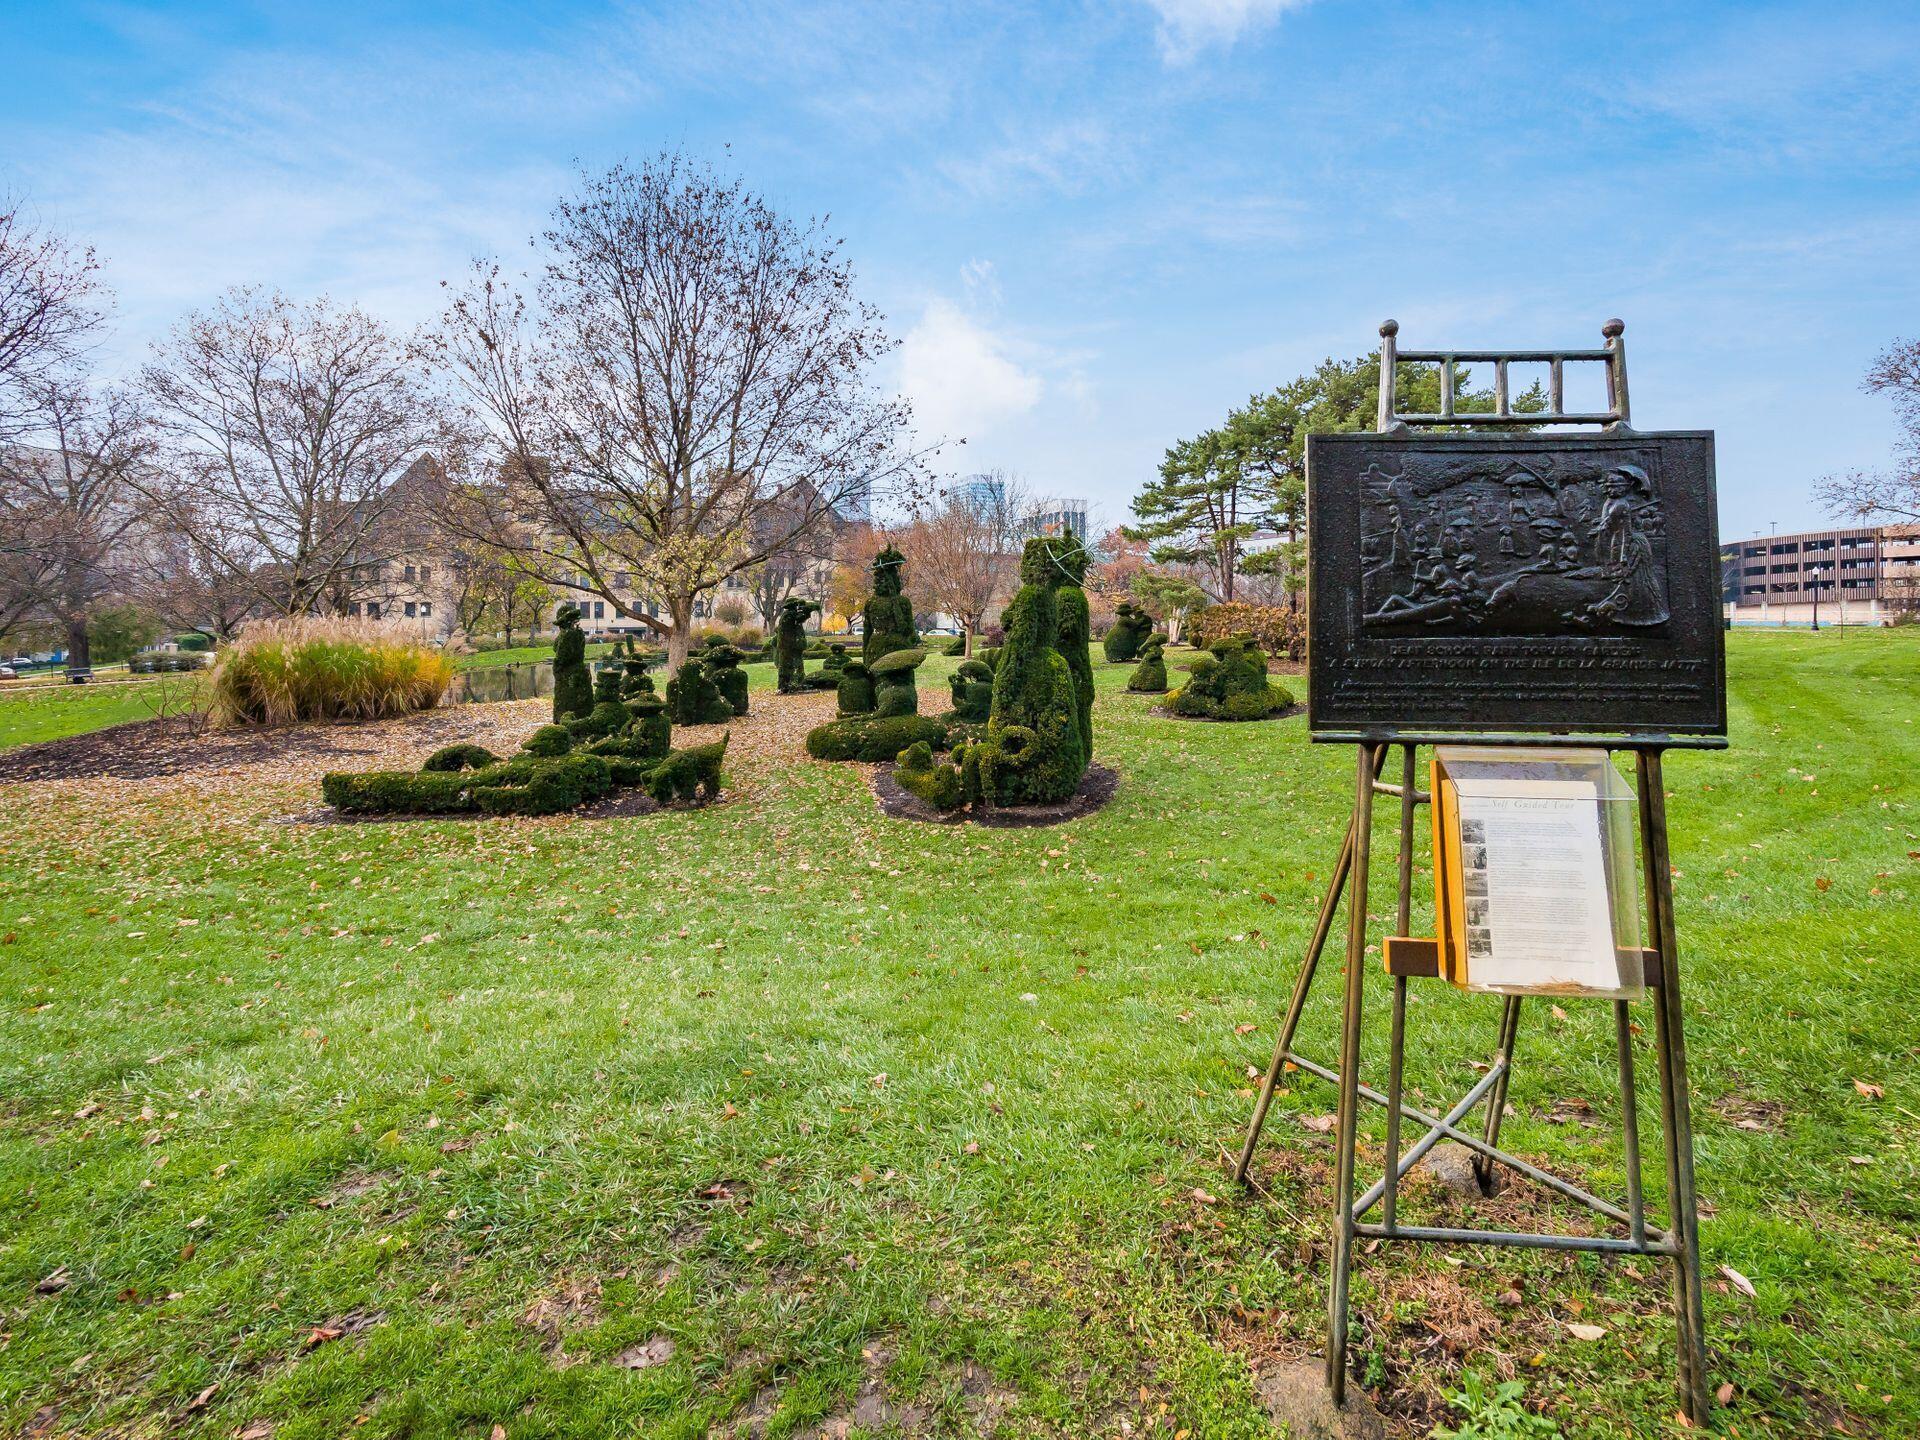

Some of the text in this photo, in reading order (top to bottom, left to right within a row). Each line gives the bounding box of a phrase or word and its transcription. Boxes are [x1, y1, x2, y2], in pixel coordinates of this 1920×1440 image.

[1389, 645, 1422, 655] DEAF
[1426, 645, 1480, 656] SCHOOL
[1483, 645, 1519, 656] PARK
[1521, 645, 1577, 656] TOPIARY
[1342, 657, 1395, 669] SUNDAY
[1397, 657, 1476, 669] AFTERNOON
[1479, 657, 1499, 669] ON
[1502, 658, 1531, 669] THE
[1556, 658, 1577, 669] DE
[1578, 658, 1597, 669] LA
[1600, 658, 1658, 670] GRANDE
[1491, 799, 1509, 809] Self
[1513, 800, 1548, 809] Guided
[1552, 800, 1576, 809] Tour
